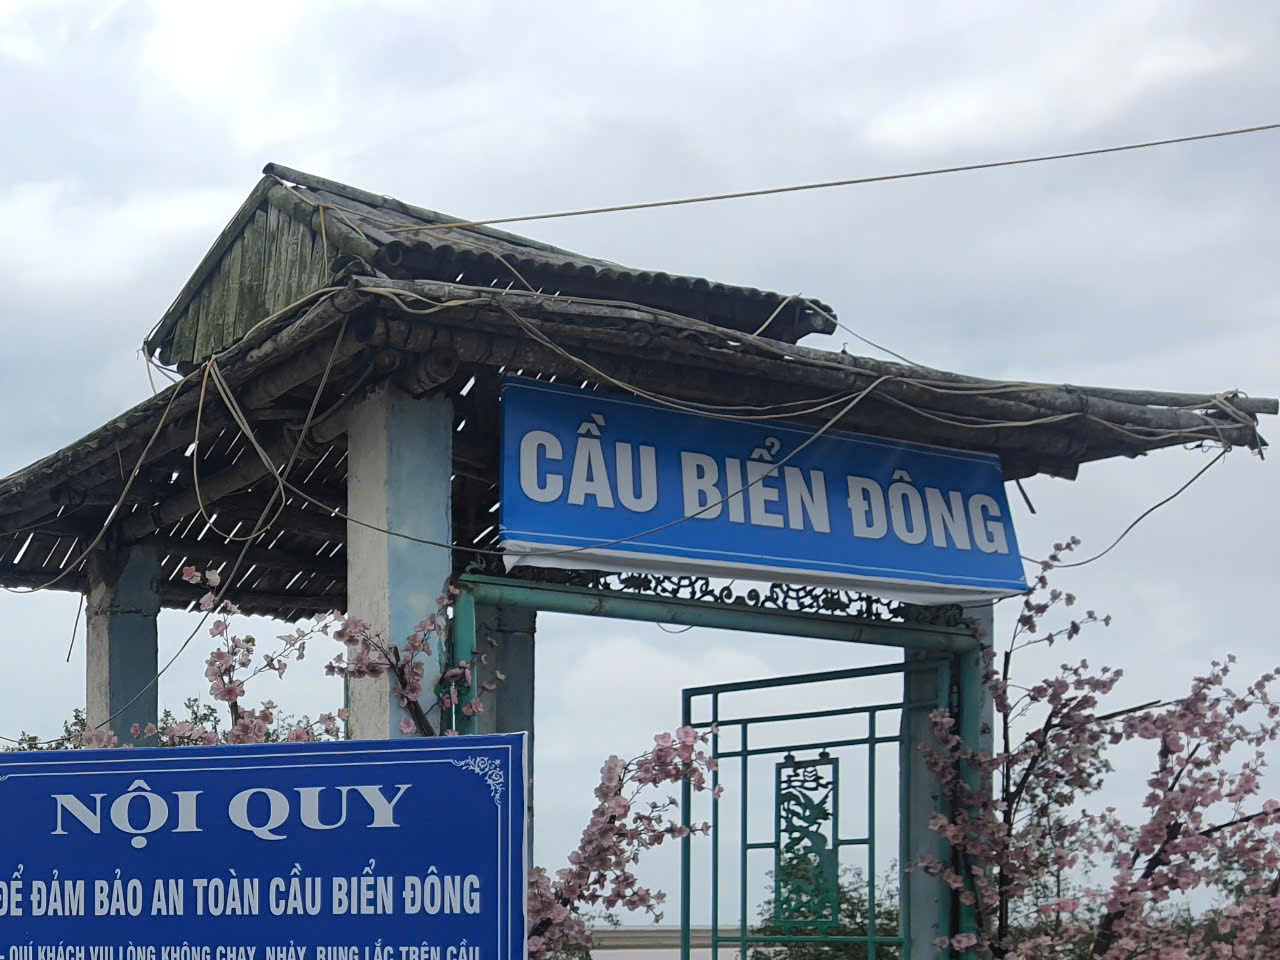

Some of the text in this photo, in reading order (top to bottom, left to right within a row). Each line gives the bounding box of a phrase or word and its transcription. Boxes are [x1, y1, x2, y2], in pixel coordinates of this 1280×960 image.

[519, 413, 1011, 556] CẦU BIỂN ĐÔNG
[50, 779, 413, 849] NỘI QUY
[31, 870, 84, 915] ĐẢM
[95, 869, 142, 916] BẢO
[151, 879, 183, 915] AN
[193, 869, 258, 916] TOÀN
[270, 863, 321, 915] CẦU
[333, 859, 392, 914] BIỂN
[403, 866, 479, 914] ĐÔNG
